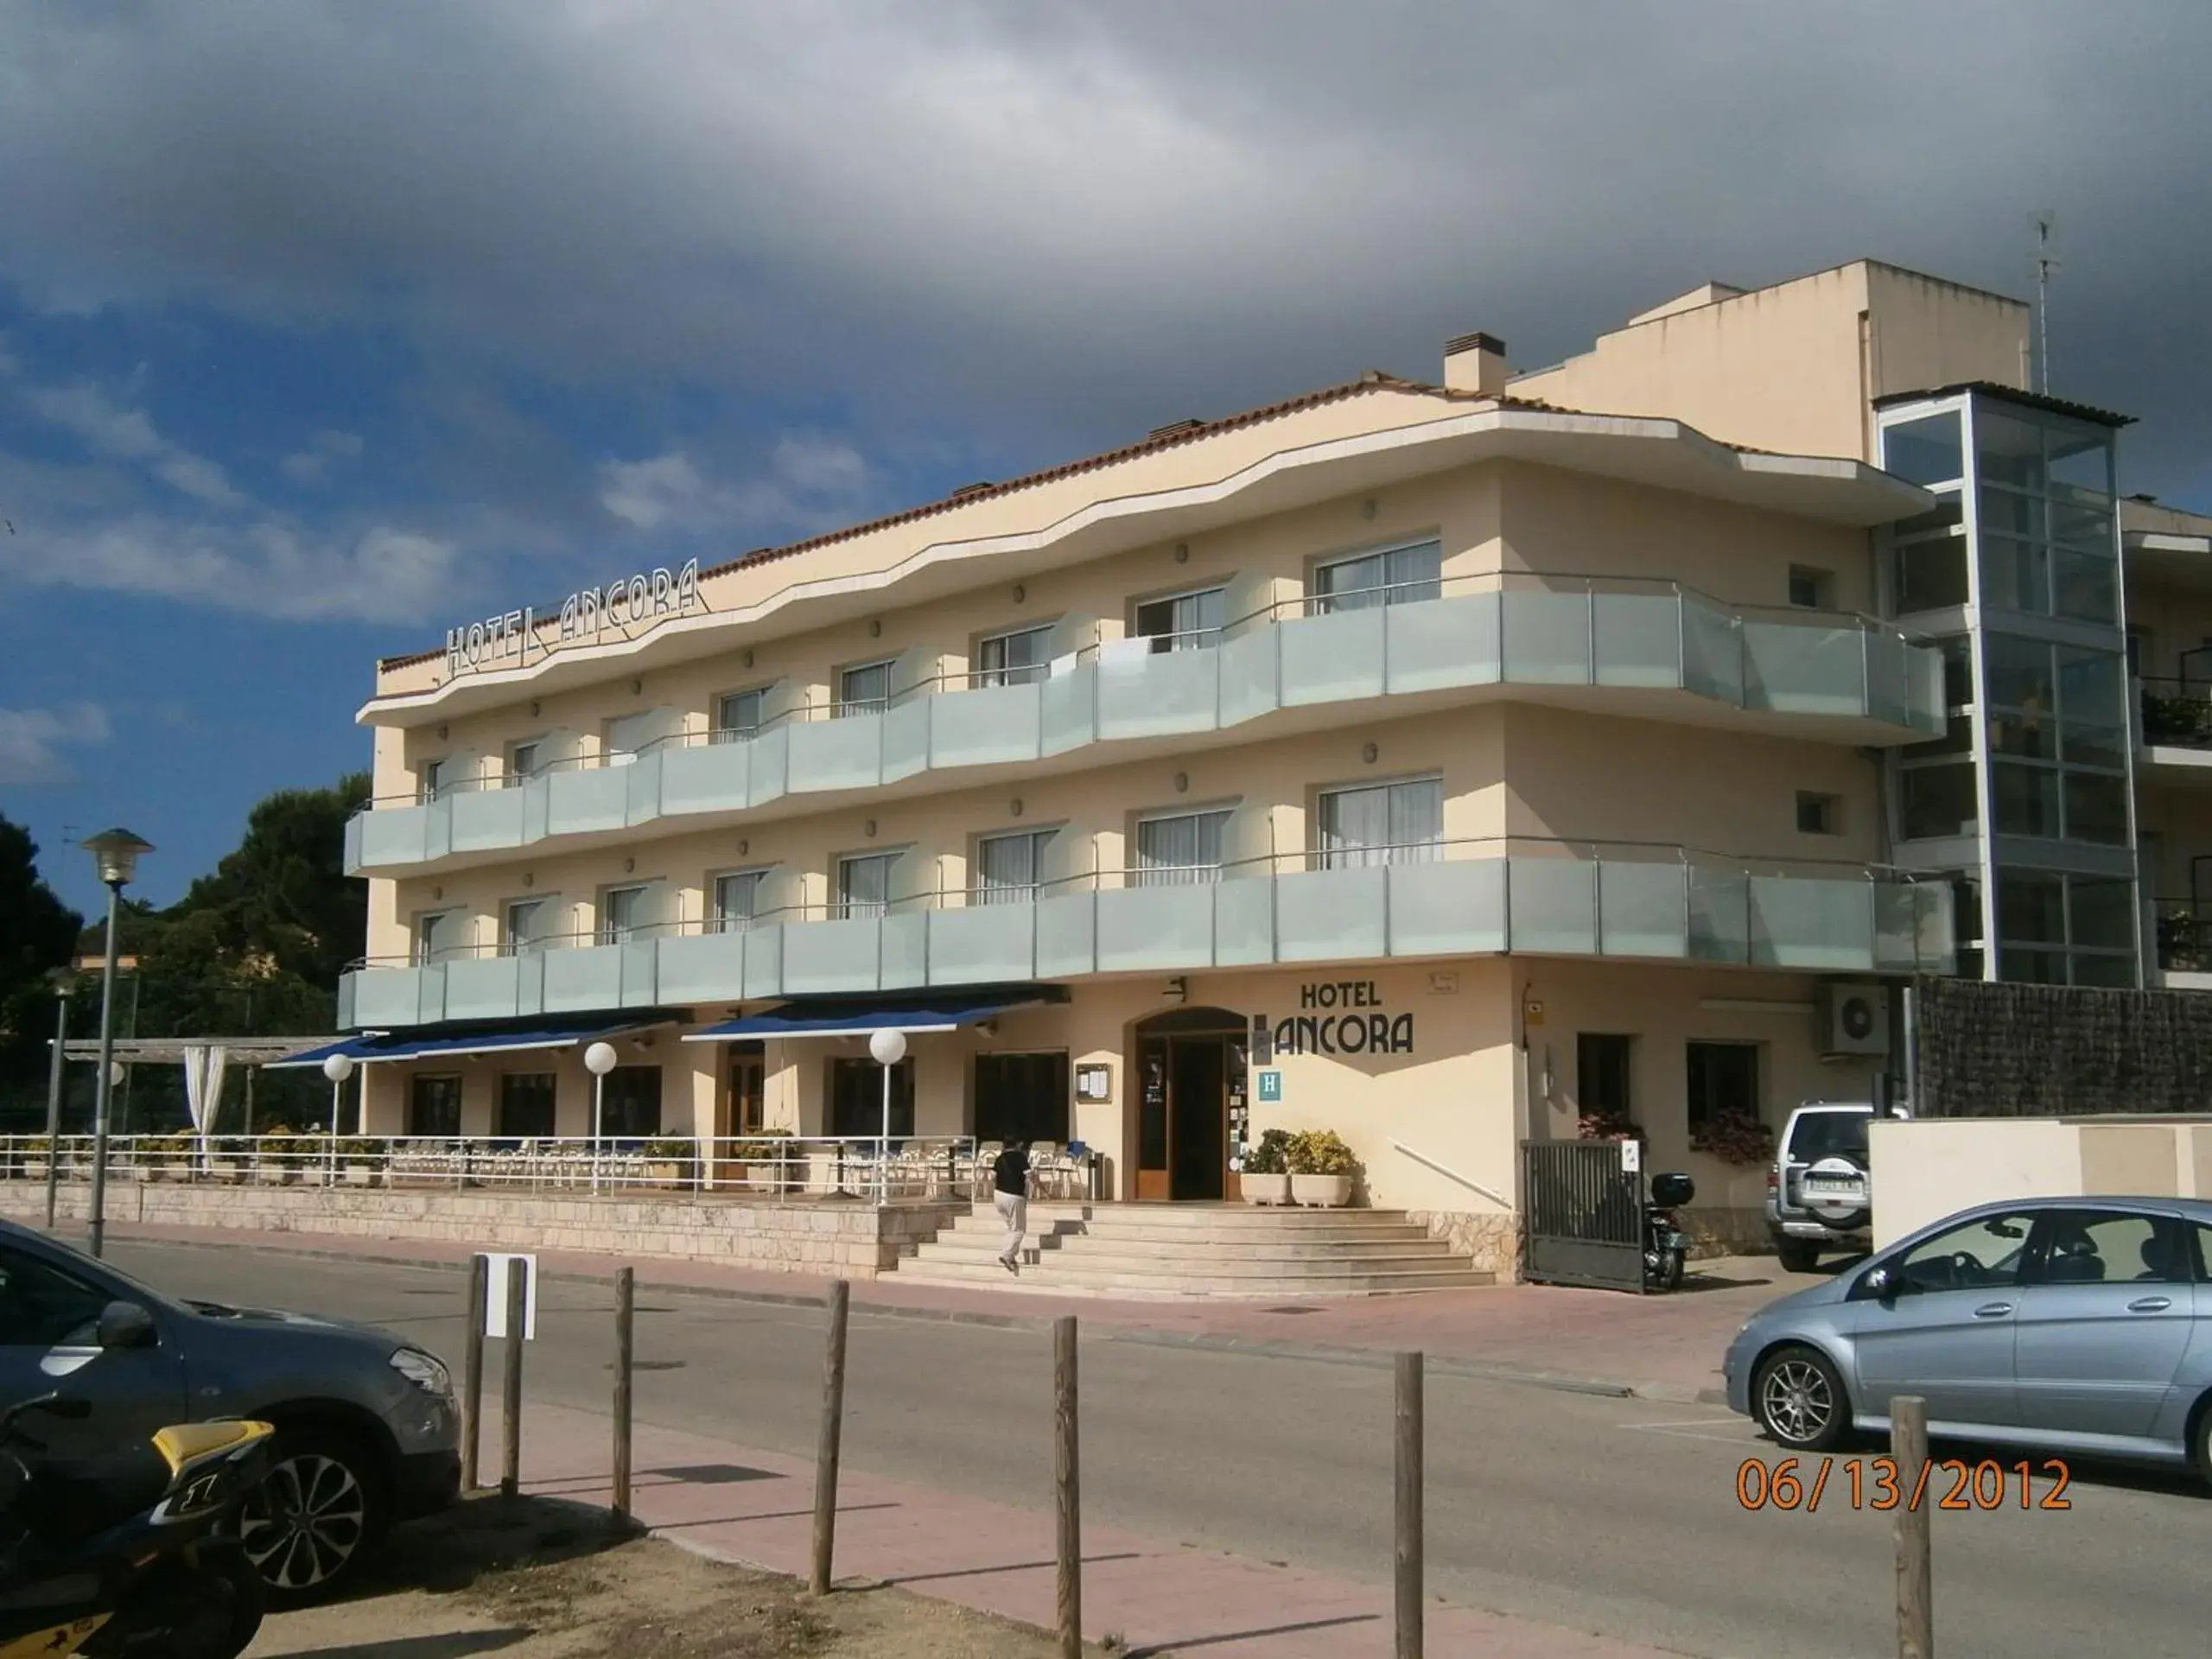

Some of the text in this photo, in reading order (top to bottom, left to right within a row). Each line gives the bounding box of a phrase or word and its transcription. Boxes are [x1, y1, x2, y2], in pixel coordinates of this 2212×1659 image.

[446, 557, 697, 672] HOTEL ANCORA
[1301, 980, 1382, 1008] HOTEL
[1274, 1013, 1414, 1056] ANCORA
[1264, 1075, 1275, 1092] H
